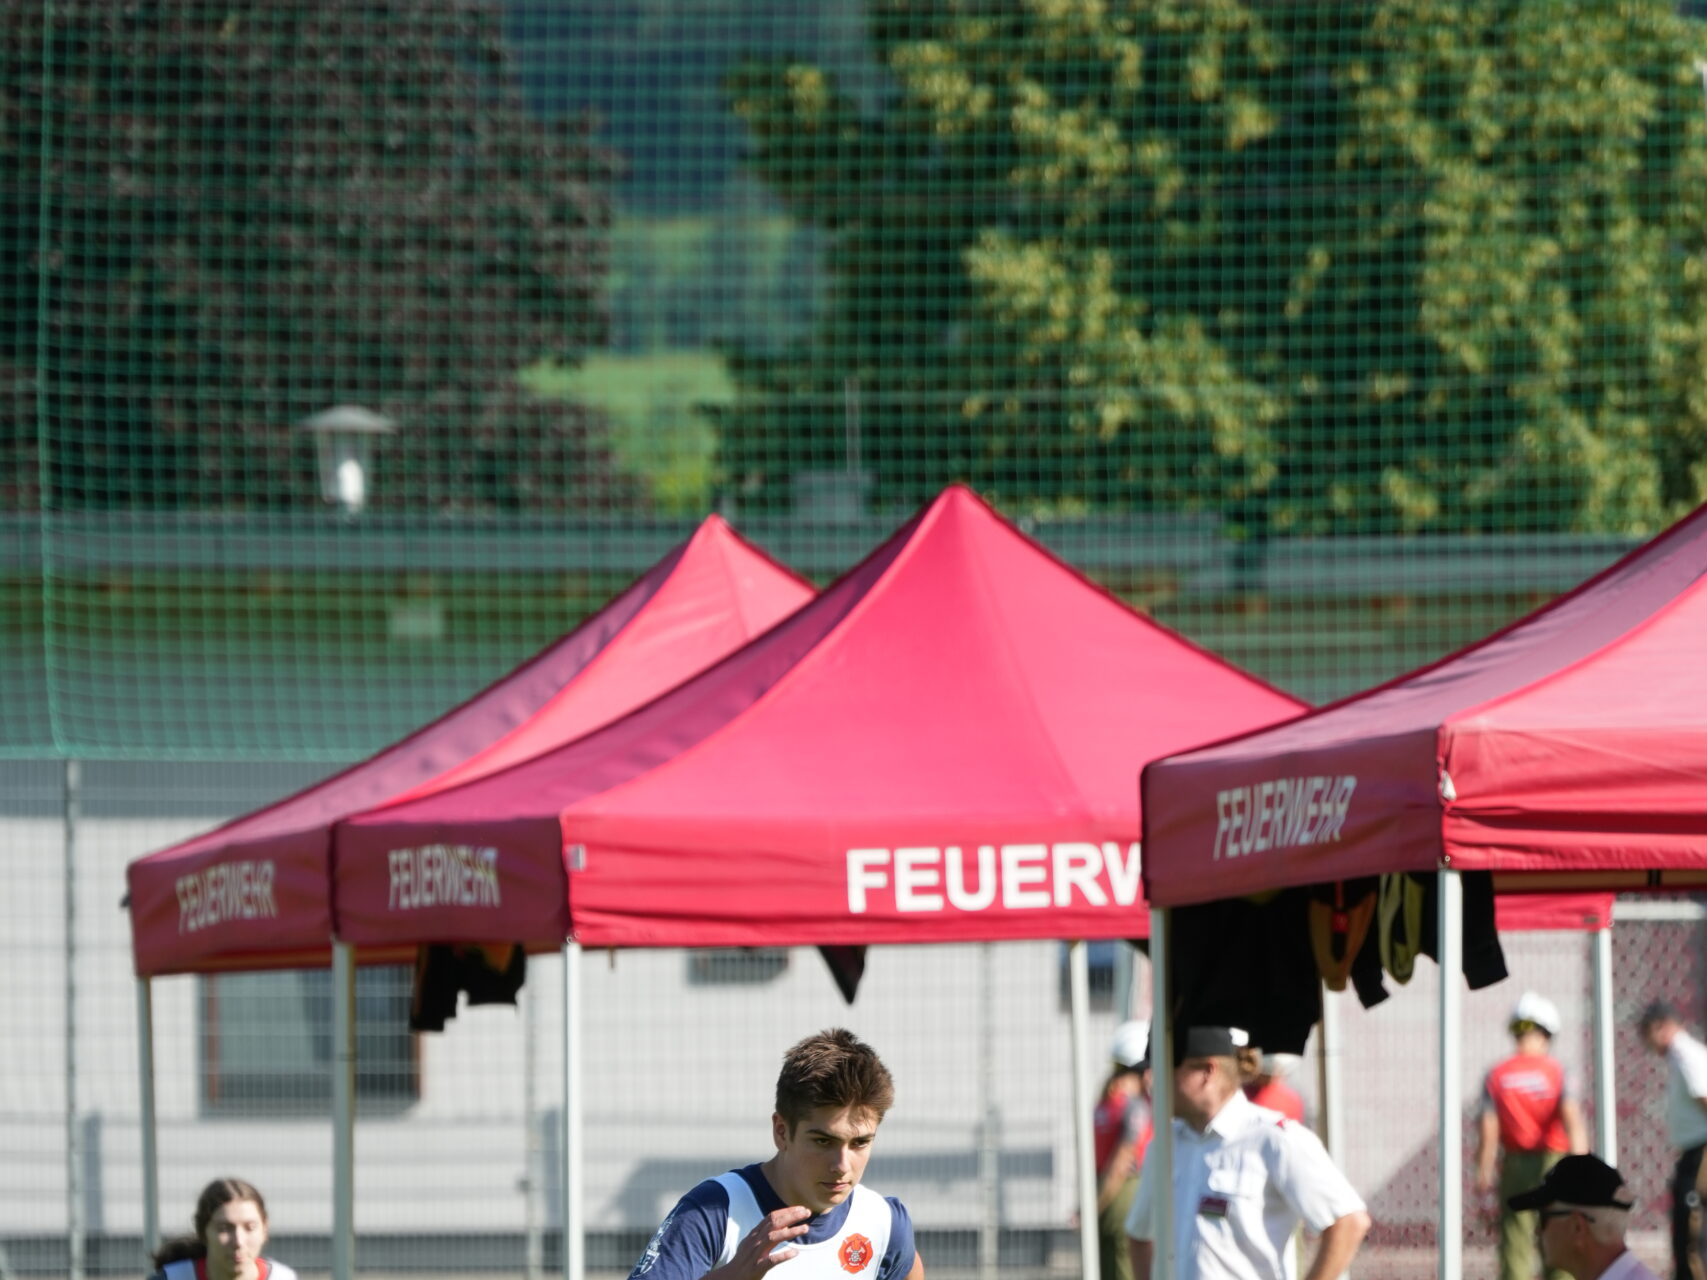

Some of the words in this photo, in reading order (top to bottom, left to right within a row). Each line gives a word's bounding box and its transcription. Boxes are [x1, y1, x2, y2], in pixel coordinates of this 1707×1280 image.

[1213, 775, 1357, 861] FEUERWEHR
[176, 861, 277, 933] FEUERWEHR
[387, 845, 501, 910] FEUERWEHR
